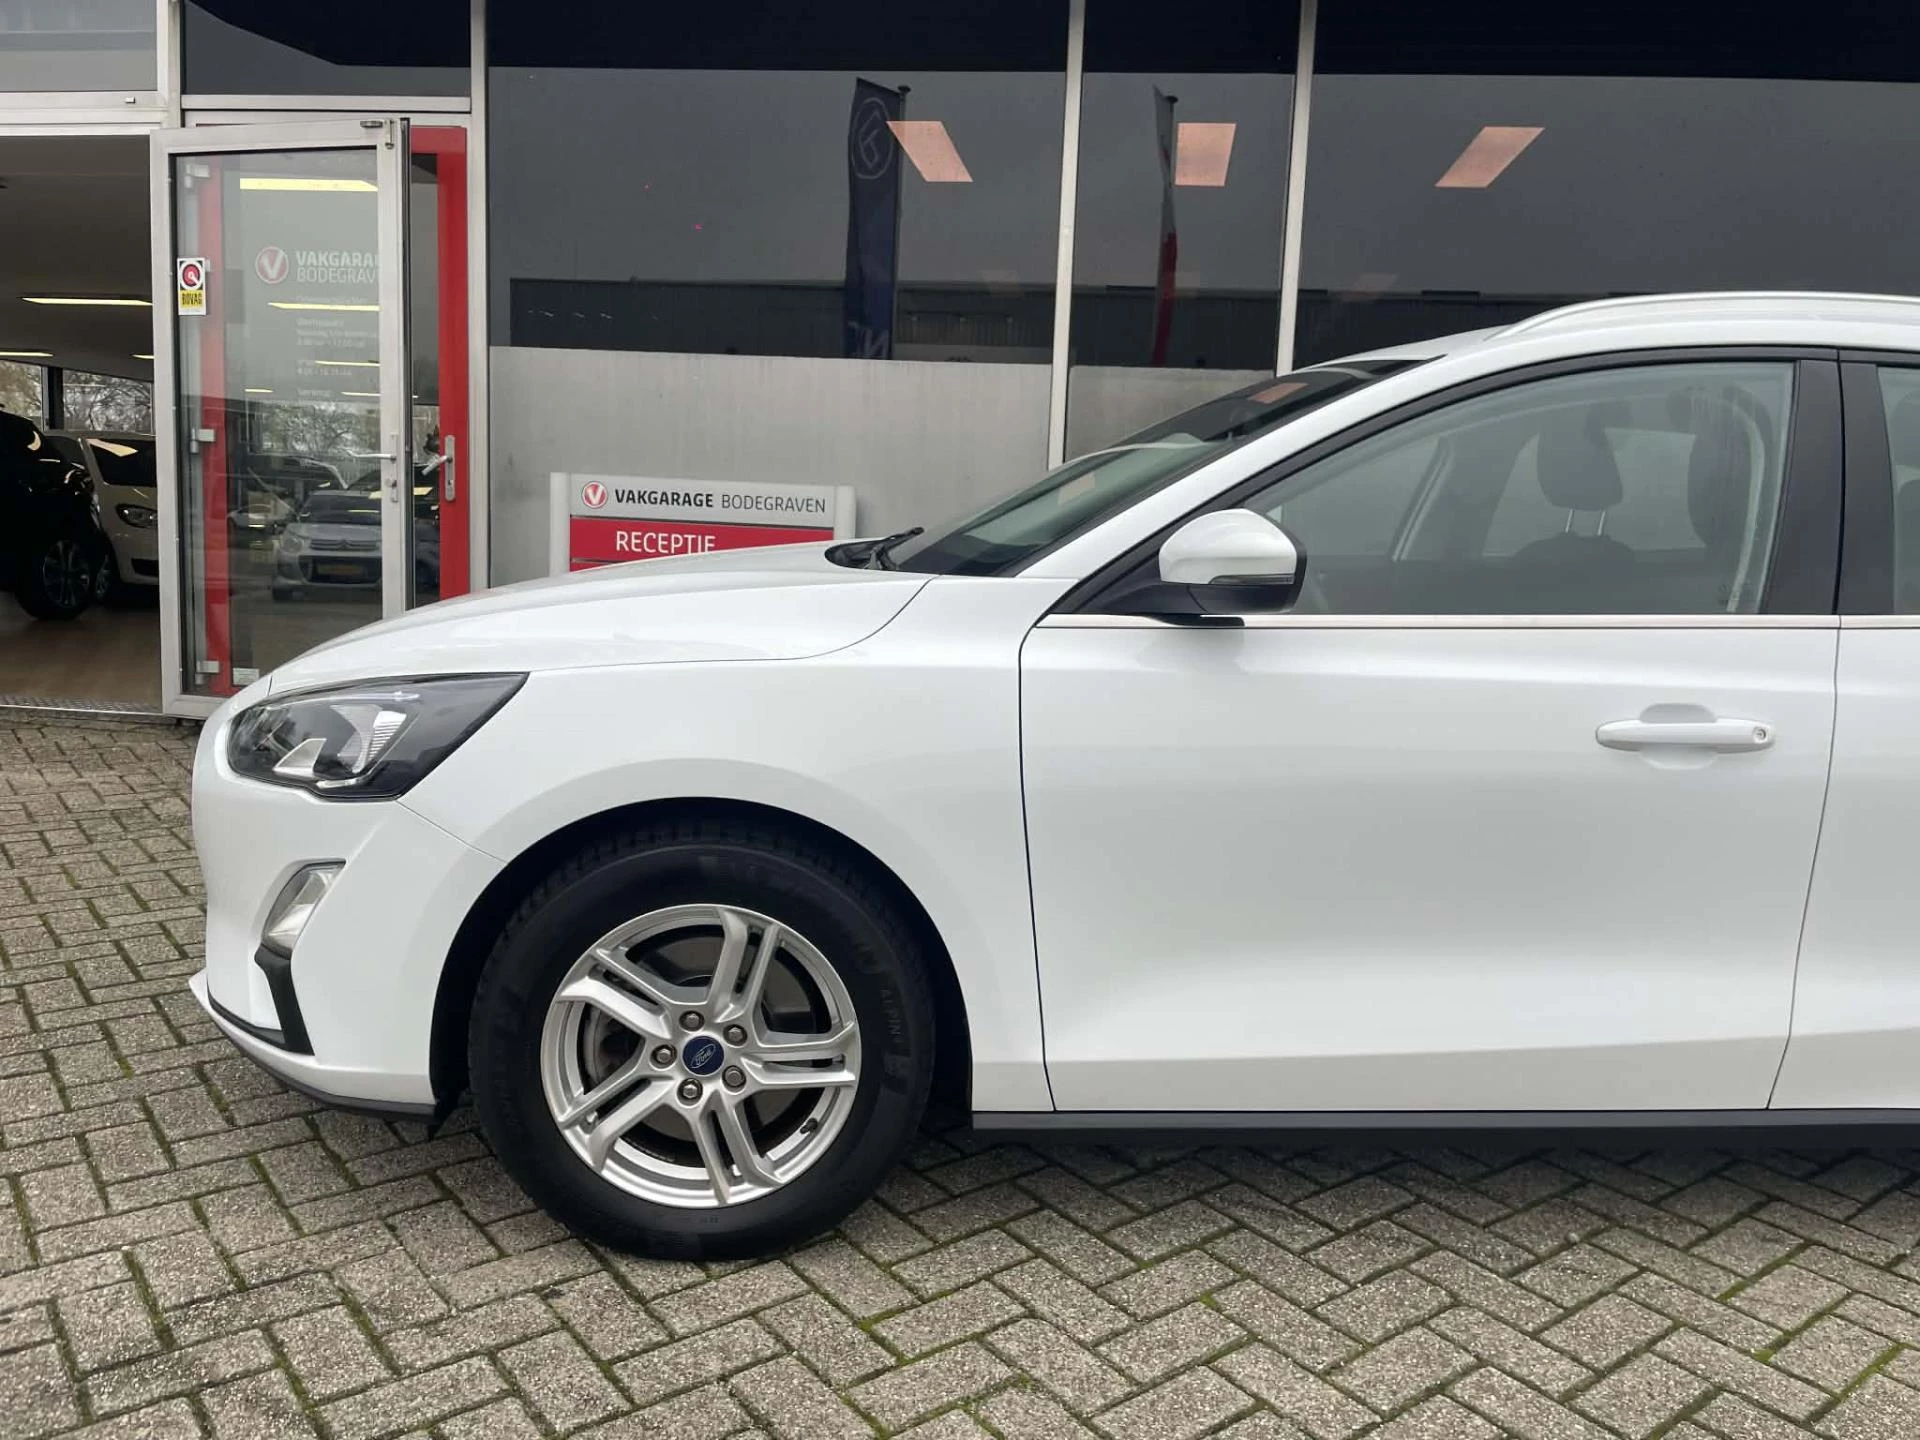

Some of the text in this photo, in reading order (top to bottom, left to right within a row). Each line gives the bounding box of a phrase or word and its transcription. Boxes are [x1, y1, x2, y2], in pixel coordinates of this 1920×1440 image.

[615, 488, 826, 513] VAKGARAGE BODEGRAVEN
[615, 530, 716, 554] RECEPTIE
